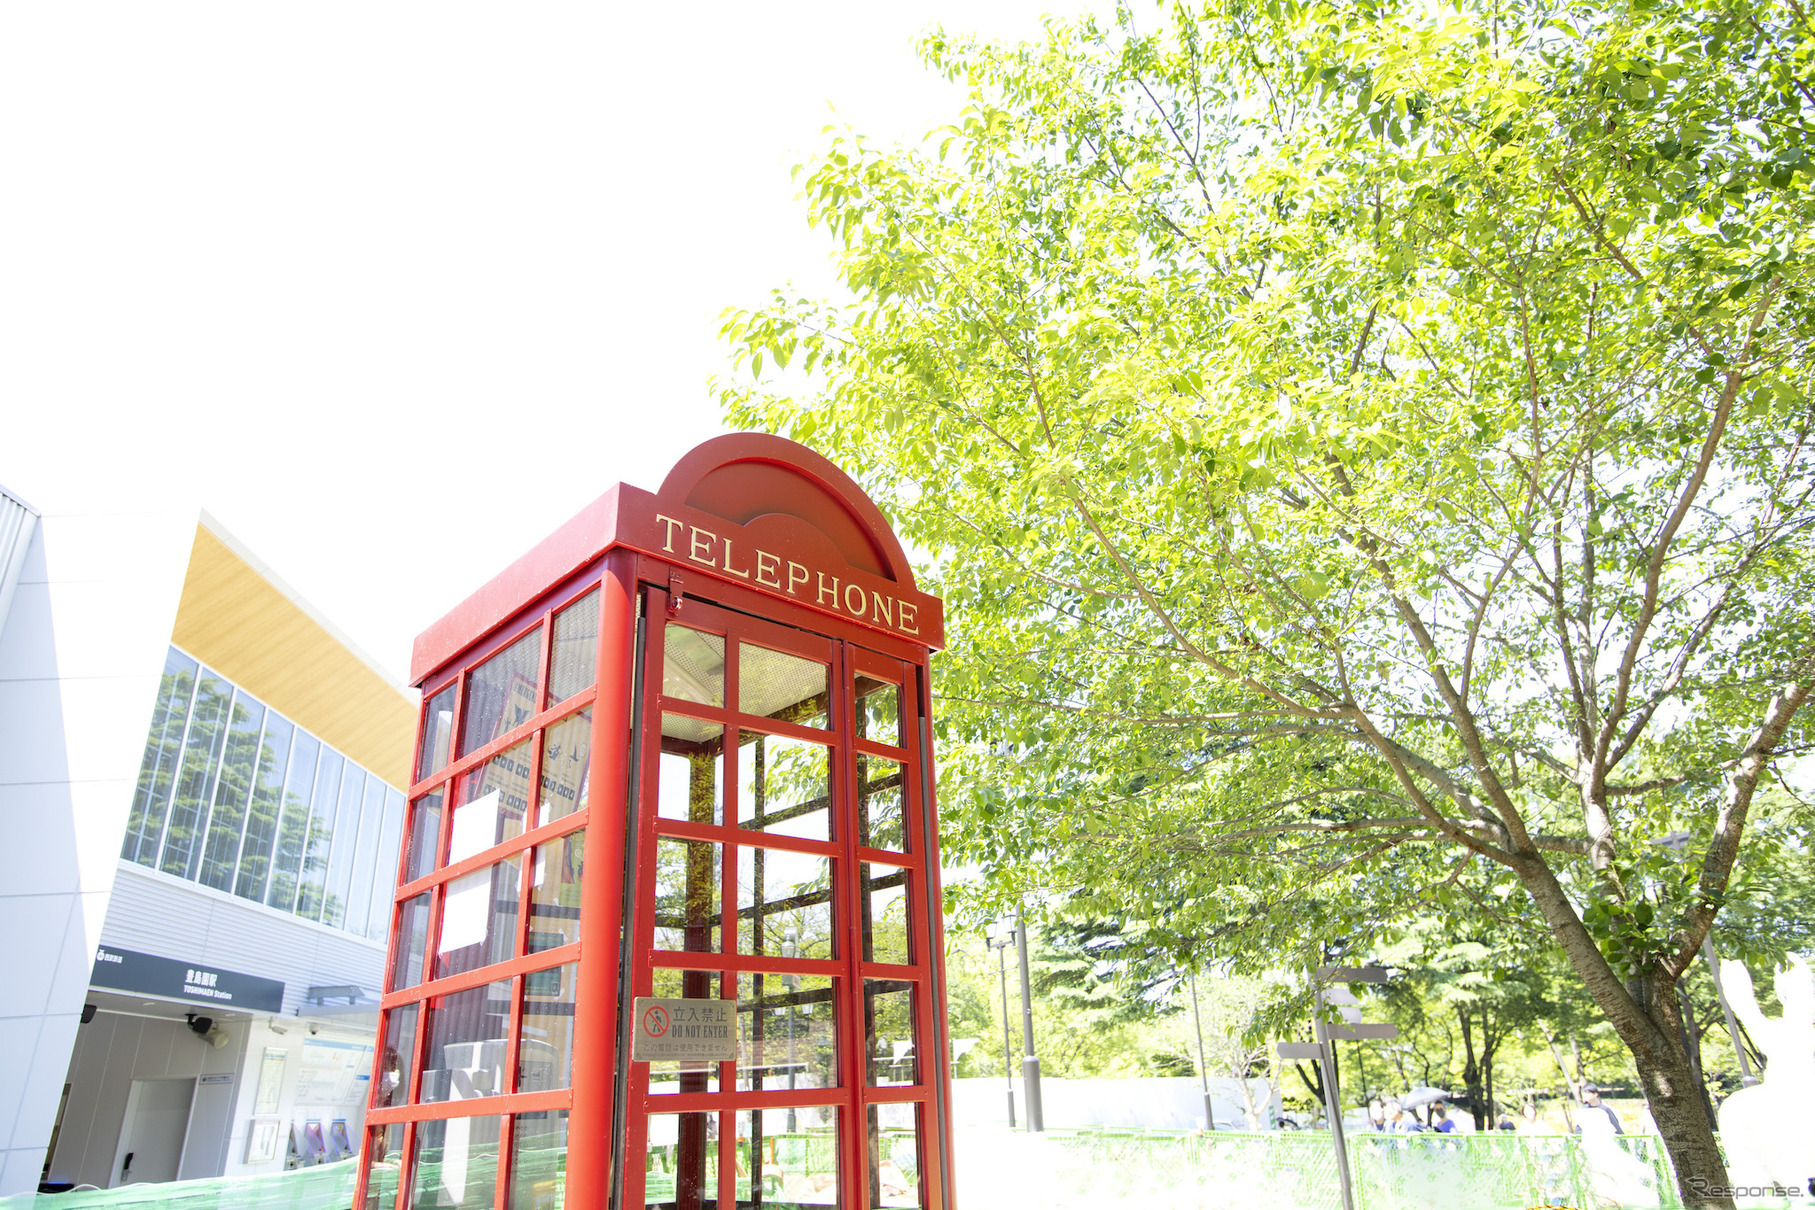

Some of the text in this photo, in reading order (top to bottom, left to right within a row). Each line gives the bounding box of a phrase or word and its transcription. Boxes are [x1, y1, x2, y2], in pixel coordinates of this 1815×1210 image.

[656, 513, 919, 635] TELEPHONE
[183, 984, 232, 1000] TOSHIMAEN Station
[673, 1006, 728, 1022] 立入禁止
[672, 1025, 728, 1038] DO NOT ENTER
